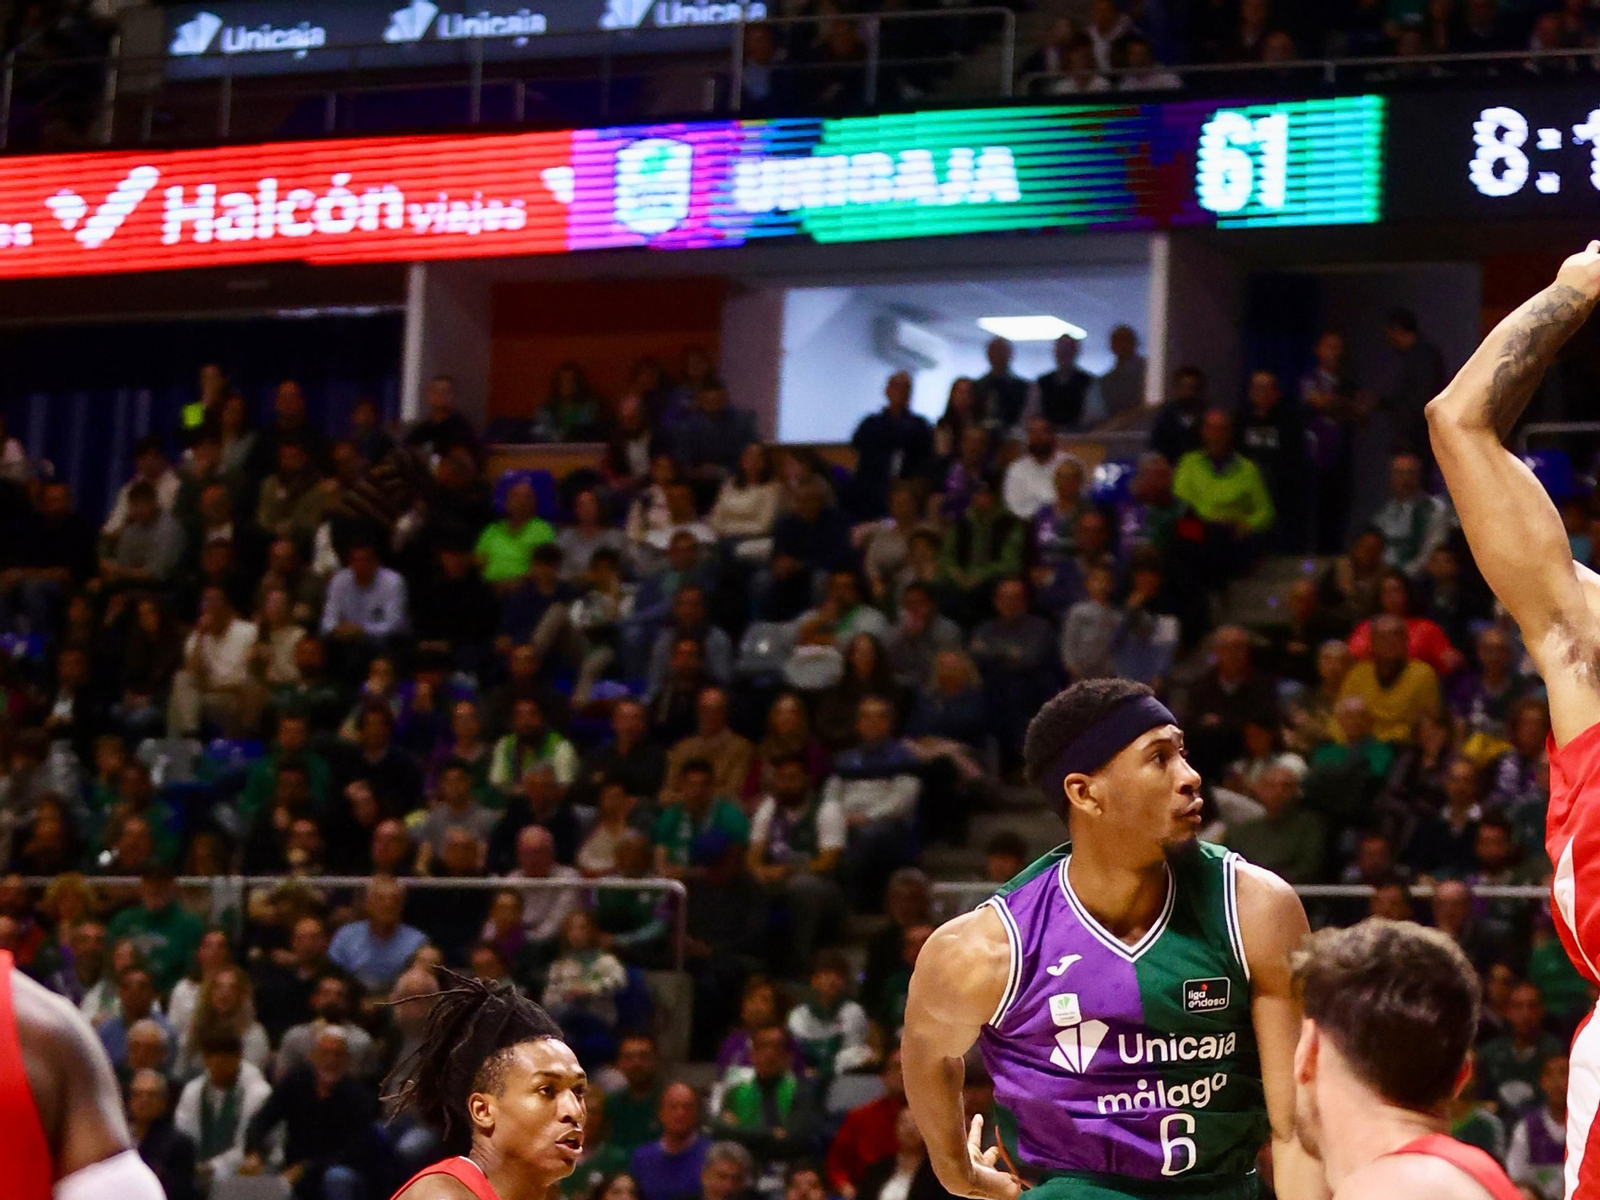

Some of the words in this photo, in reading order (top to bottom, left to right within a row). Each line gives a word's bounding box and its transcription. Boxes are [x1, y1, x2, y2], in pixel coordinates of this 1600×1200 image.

[220, 21, 326, 59] Unicaja
[436, 8, 547, 47] Unicaja
[1196, 111, 1289, 212] 61
[160, 172, 404, 245] Halcón
[1118, 1032, 1236, 1064] Unicaja
[1160, 1112, 1197, 1177] 6
